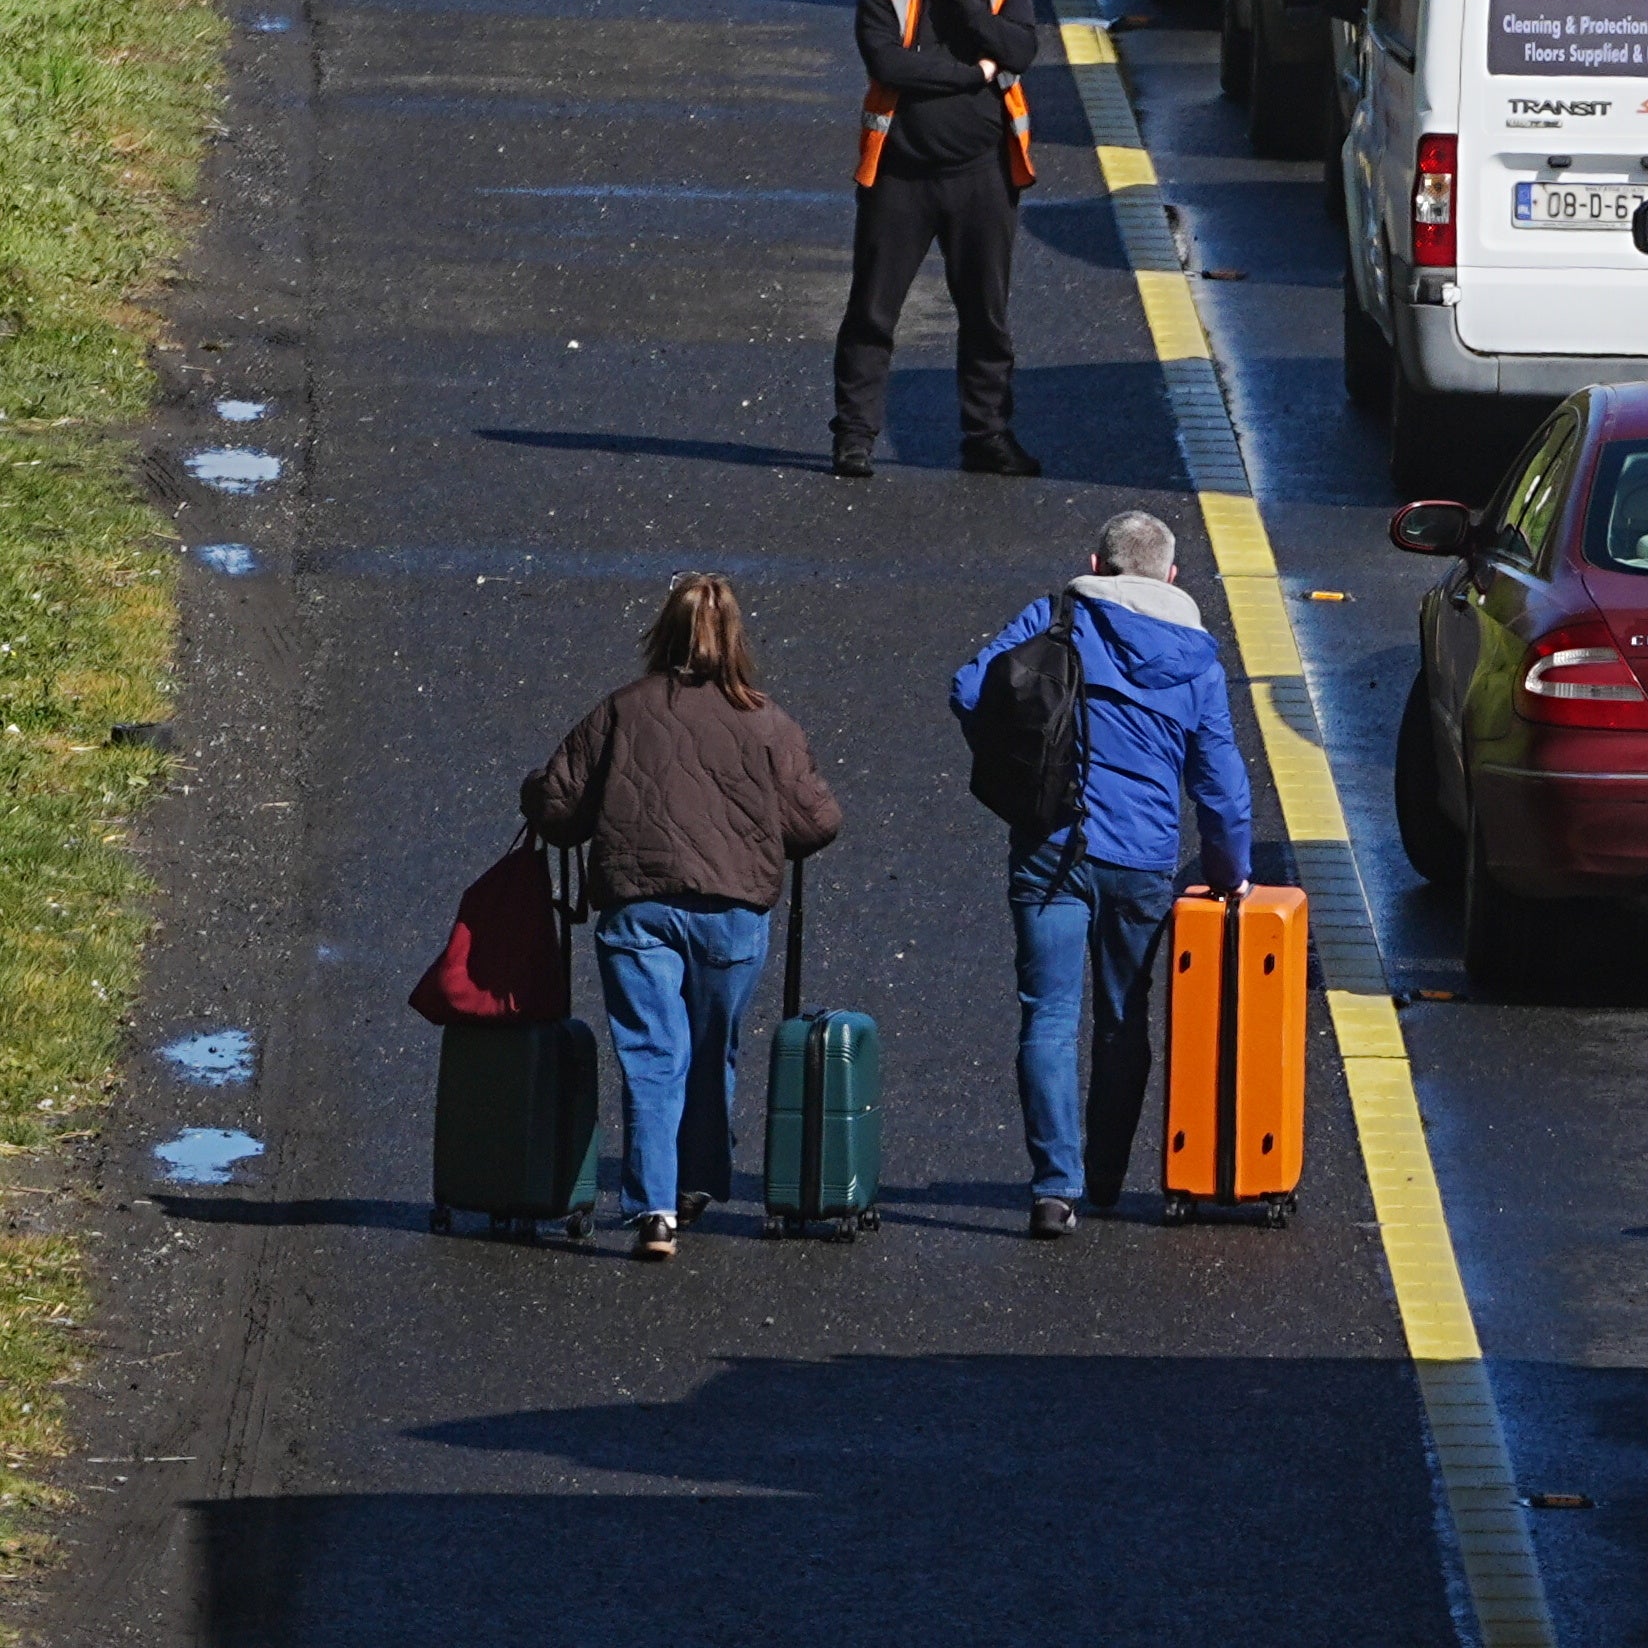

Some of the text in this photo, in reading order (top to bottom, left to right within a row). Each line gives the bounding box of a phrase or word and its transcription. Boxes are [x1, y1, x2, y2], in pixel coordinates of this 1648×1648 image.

[1502, 13, 1561, 39] Cleaning
[1565, 16, 1577, 35] &
[1580, 14, 1648, 35] Protection
[1524, 42, 1566, 62] Floors
[1569, 42, 1629, 67] Supplied
[1633, 44, 1644, 64] &
[1508, 98, 1613, 116] TRANSIT
